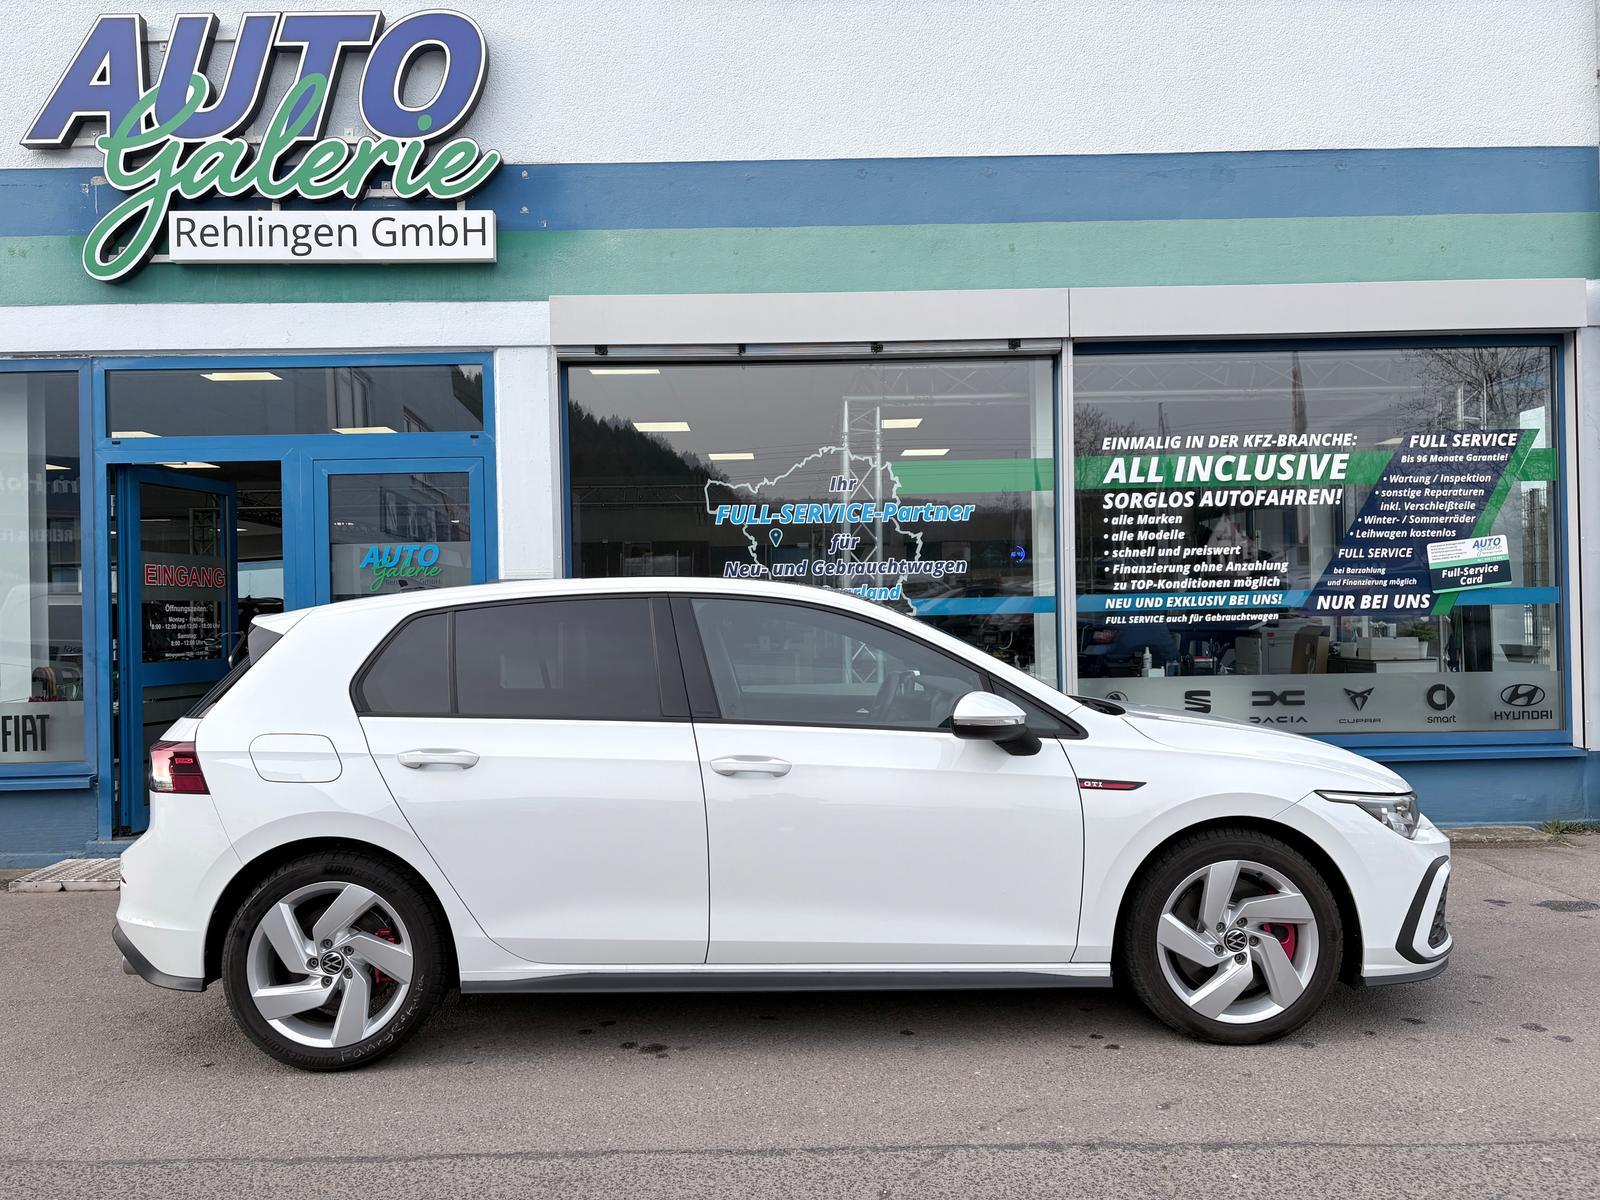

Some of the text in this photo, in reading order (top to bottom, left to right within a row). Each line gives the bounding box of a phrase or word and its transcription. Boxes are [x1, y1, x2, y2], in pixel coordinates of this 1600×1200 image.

[20, 9, 490, 150] AUTO
[82, 72, 503, 284] Galerie
[174, 215, 488, 256] Rehlingen GmbH
[1101, 432, 1358, 450] EINMALIG IN DER KFZ-BRANCHE:
[1409, 432, 1518, 448] FULL SERVICE
[1400, 452, 1509, 463] Bis 96 Monate Garantie!
[1102, 453, 1350, 484] ALL INCLUSIVE
[828, 474, 858, 493] Ihr
[1389, 474, 1431, 485] Wartung
[1440, 473, 1492, 484] Inspektion
[1102, 488, 1344, 510] SORGLOS AUTOFAHREN!
[1380, 488, 1485, 499] sonstige Reparaturen
[715, 503, 976, 525] FULL-SERVICE-Partner
[1380, 501, 1476, 512] inkl. Verschleißteile
[1111, 513, 1183, 525] alle Marken
[1363, 515, 1401, 525] Winter-
[1408, 514, 1476, 524] Sommerräder
[1111, 529, 1185, 542] alle Modelle
[1355, 528, 1457, 539] Leihwagen kostenlos
[828, 533, 861, 555] für
[1472, 537, 1502, 549] AUTO
[360, 543, 440, 569] AUTO
[1111, 544, 1241, 559] schnell und preiswert
[1338, 547, 1413, 558] FULL SERVICE
[369, 556, 442, 593] Galerie
[723, 557, 968, 578] Neu- und Gebrauchtwagen
[1113, 560, 1289, 576] Finanzierung ohne Anzahlung
[1333, 566, 1387, 576] bei Barzahlung
[1441, 564, 1499, 579] Full-Service
[144, 563, 226, 589] EINGANG
[1113, 575, 1281, 591] zu TOP-Konditionen möglich
[1342, 578, 1388, 587] Finanzierung
[1389, 577, 1417, 587] möglich
[1460, 574, 1483, 586] Card
[1105, 593, 1283, 609] NEU UND EXKLUSIV BEI UNS!
[1316, 593, 1431, 610] NUR BEI UNS
[1105, 612, 1279, 624] FULL SERVICE auch für Gebrauchtwagen
[1249, 716, 1308, 724] DACIA
[1427, 714, 1457, 723] smart
[1494, 710, 1553, 721] HYUNDAI
[1, 714, 50, 752] FIAT
[1083, 780, 1104, 788] GTI
